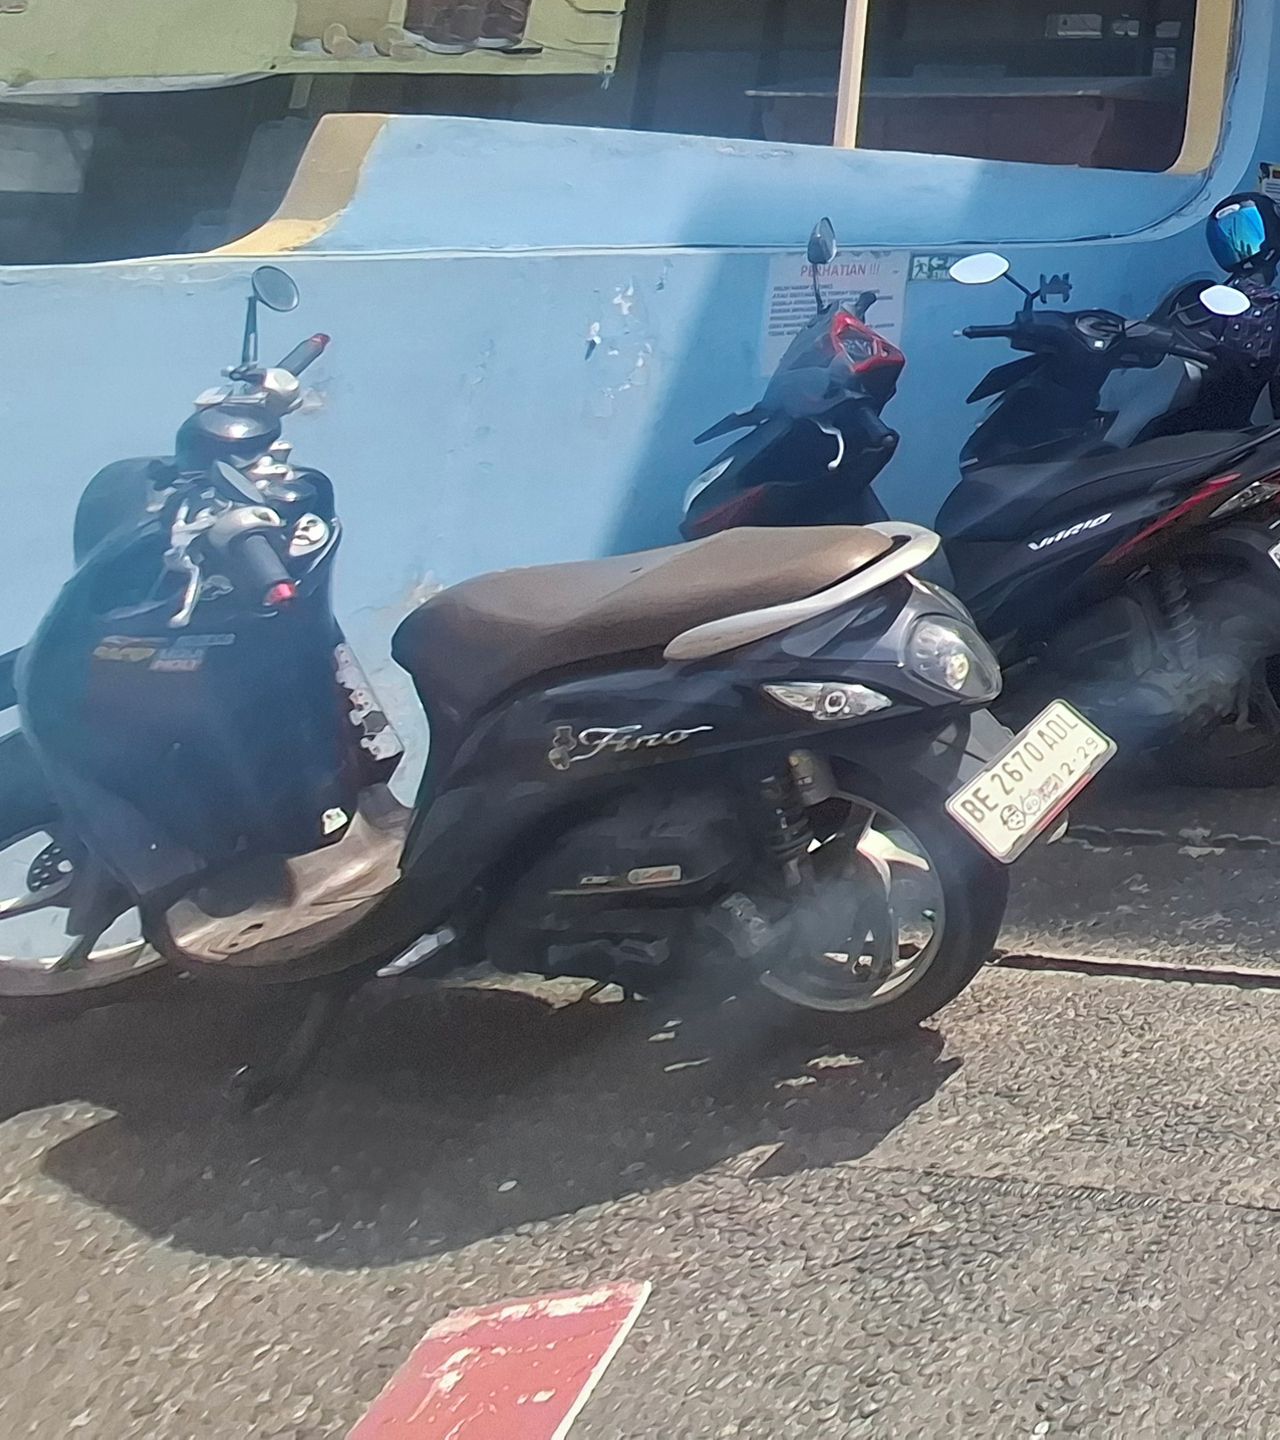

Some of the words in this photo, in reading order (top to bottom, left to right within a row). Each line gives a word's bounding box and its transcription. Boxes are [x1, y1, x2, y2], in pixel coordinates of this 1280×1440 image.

[569, 723, 714, 762] Fino
[960, 786, 999, 824] BE
[990, 741, 1045, 796] 2670
[1037, 713, 1079, 752] ADL
